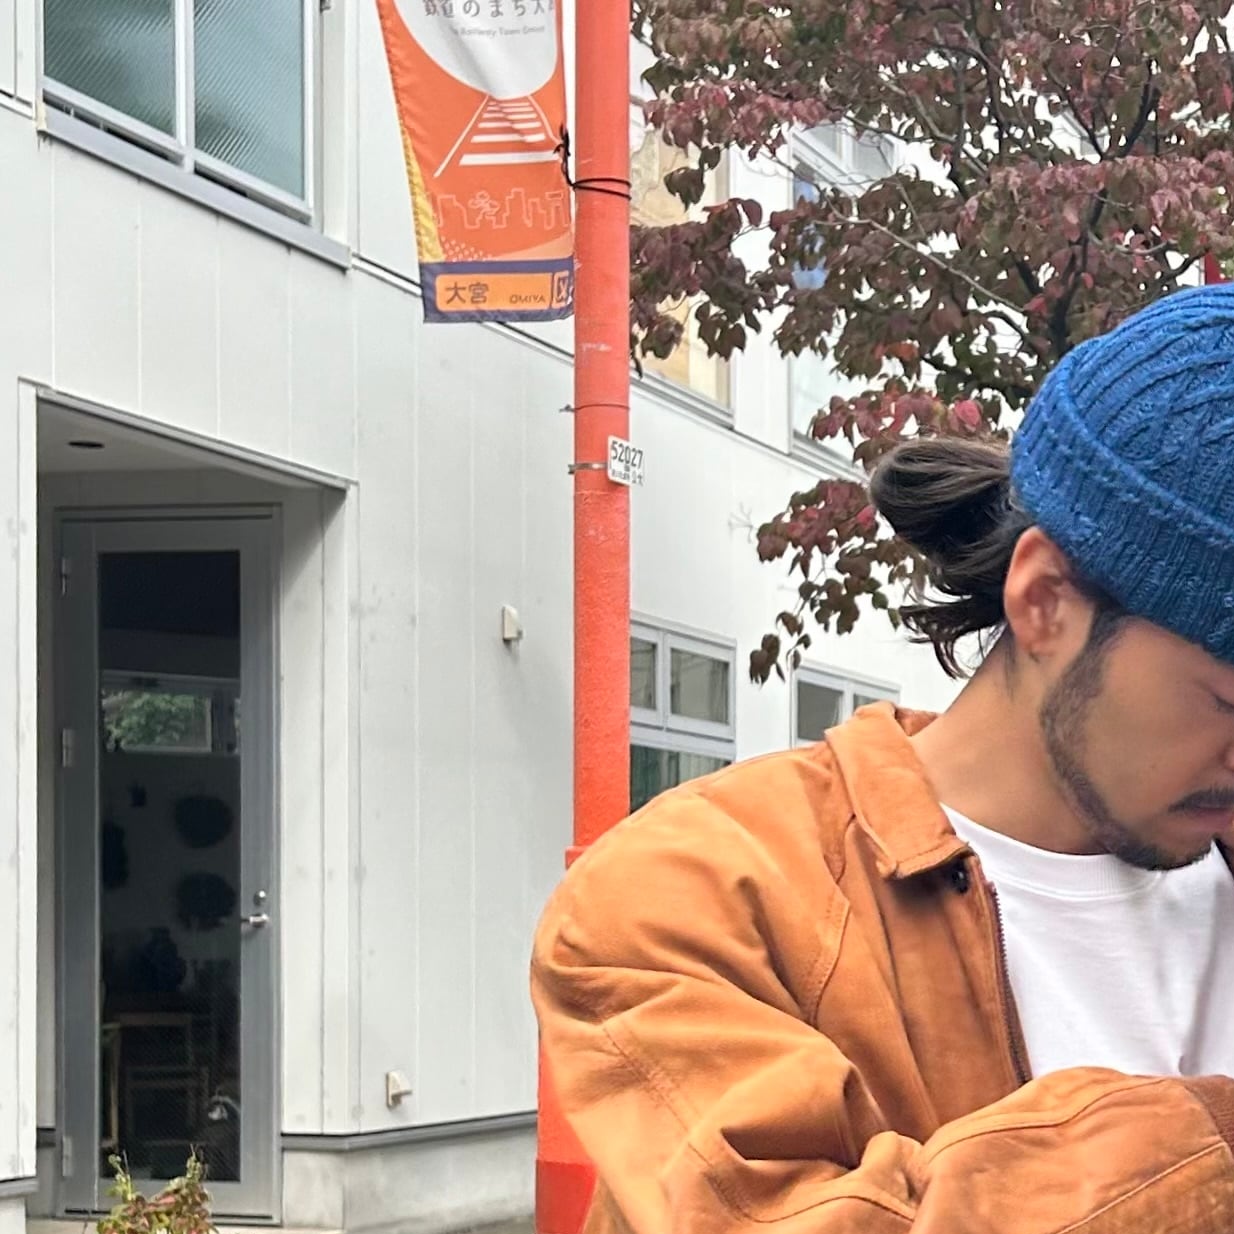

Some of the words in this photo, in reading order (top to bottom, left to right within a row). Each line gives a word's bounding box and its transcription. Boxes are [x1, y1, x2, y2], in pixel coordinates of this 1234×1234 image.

[445, 282, 489, 304] 大宮
[509, 293, 546, 304] OMIYA
[611, 440, 643, 469] 52027
